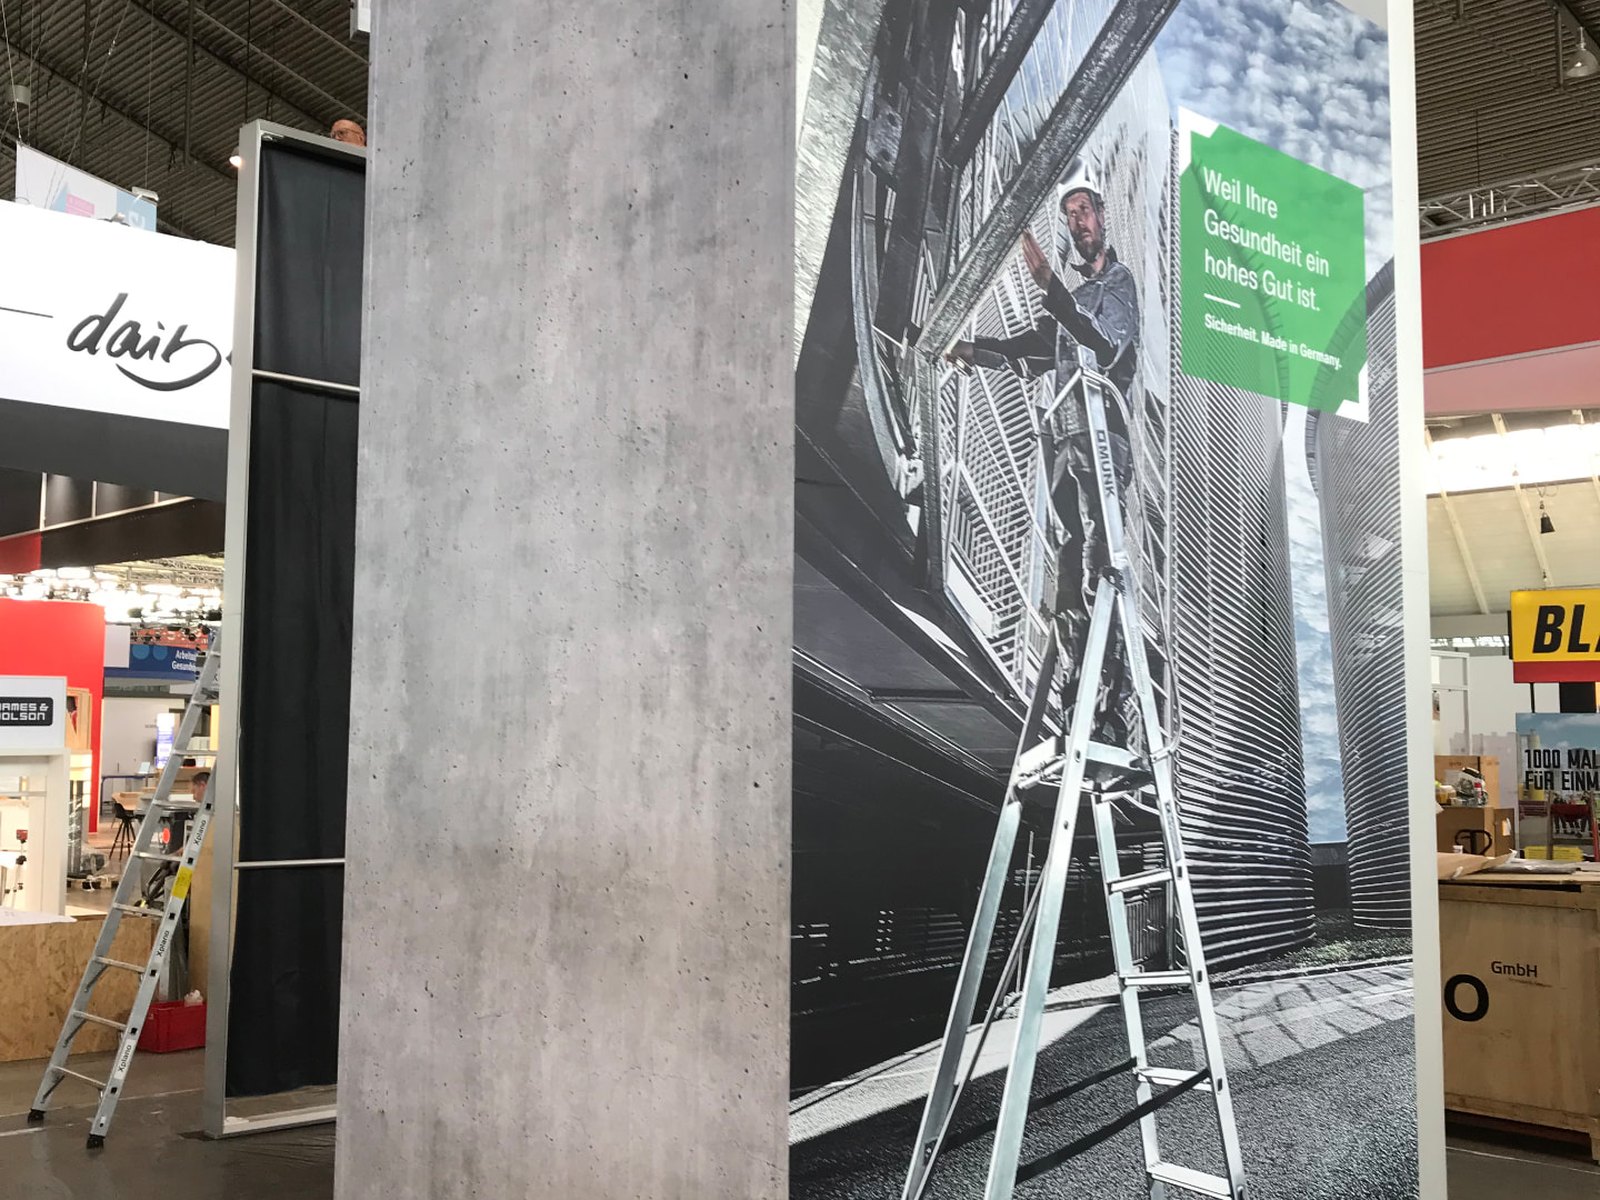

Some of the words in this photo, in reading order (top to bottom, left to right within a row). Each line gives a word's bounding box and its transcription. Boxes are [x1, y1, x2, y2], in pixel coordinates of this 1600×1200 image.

[1203, 166, 1241, 205] Weil
[1246, 183, 1278, 219] Ihre
[1204, 208, 1302, 267] Gesundheit
[1306, 250, 1330, 277] ein
[1204, 247, 1258, 290] hohes
[1262, 269, 1293, 302] Gut
[1297, 281, 1320, 311] ist.
[1204, 313, 1260, 343] Sicherheit.
[1261, 330, 1288, 351] Made
[1289, 339, 1299, 355] in
[1299, 343, 1343, 371] Germany.
[1099, 445, 1116, 498] MUNK
[1532, 604, 1600, 654] BL
[0, 702, 37, 711] AMES
[39, 702, 49, 711] &
[0, 712, 46, 721] OLSON
[1524, 749, 1561, 769] 1000
[1567, 749, 1600, 769] MAL
[1525, 770, 1554, 790] FÜR
[156, 930, 170, 957] Xplano
[1491, 960, 1538, 978] GmbH
[117, 1044, 132, 1073] Xplano
